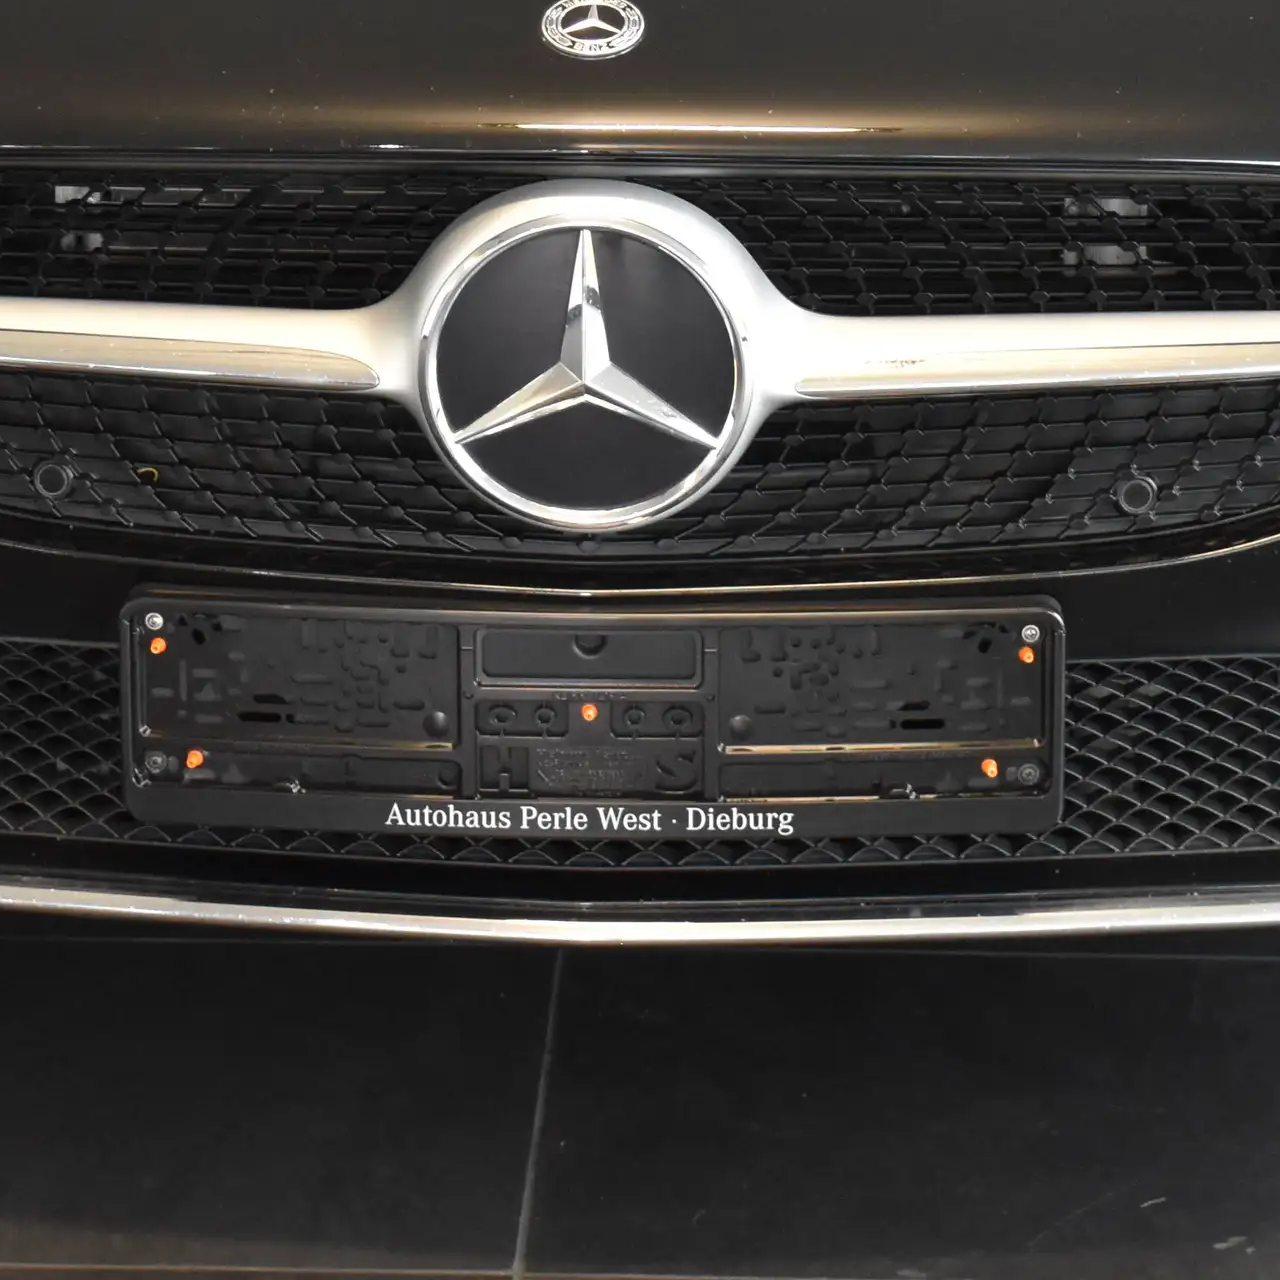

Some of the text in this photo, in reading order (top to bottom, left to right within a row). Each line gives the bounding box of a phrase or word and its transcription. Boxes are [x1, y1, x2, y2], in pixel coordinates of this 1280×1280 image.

[384, 801, 512, 829] Autohaus
[519, 805, 589, 831] Perle
[595, 806, 663, 832] West
[685, 806, 795, 837] Dieburg
